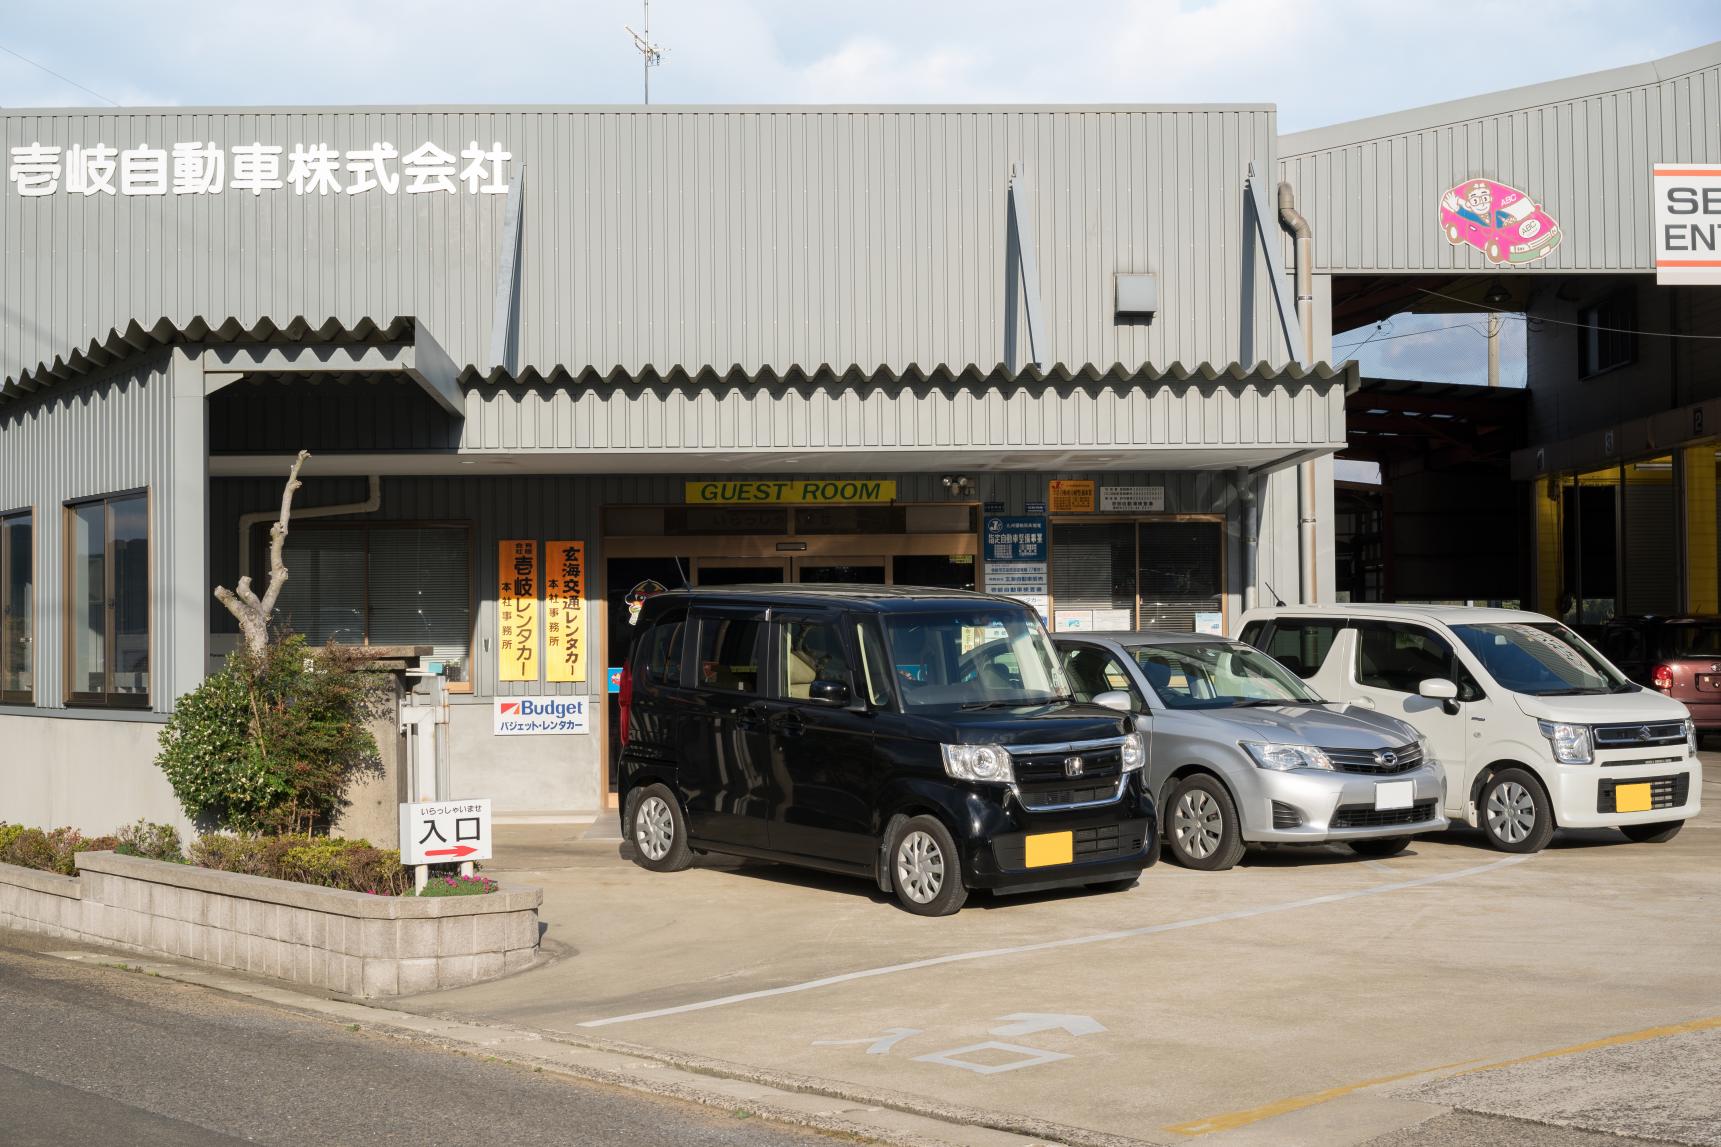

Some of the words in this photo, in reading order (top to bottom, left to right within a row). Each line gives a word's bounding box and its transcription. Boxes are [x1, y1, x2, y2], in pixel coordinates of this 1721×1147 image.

[10, 141, 512, 196] 壱岐自動車株式会社
[1501, 194, 1517, 206] ABC
[1521, 221, 1537, 235] ABC
[701, 483, 788, 501] GUEST
[802, 483, 881, 500] ROOM
[501, 582, 513, 650] 本社事務所
[514, 555, 533, 676] 壱岐レンタカー
[548, 579, 560, 647] 本社事務所
[562, 546, 580, 675] 玄海交通レンタカー
[522, 700, 582, 718] Budget
[421, 805, 482, 816] いらっしゃいませ
[418, 817, 480, 844] 入口
